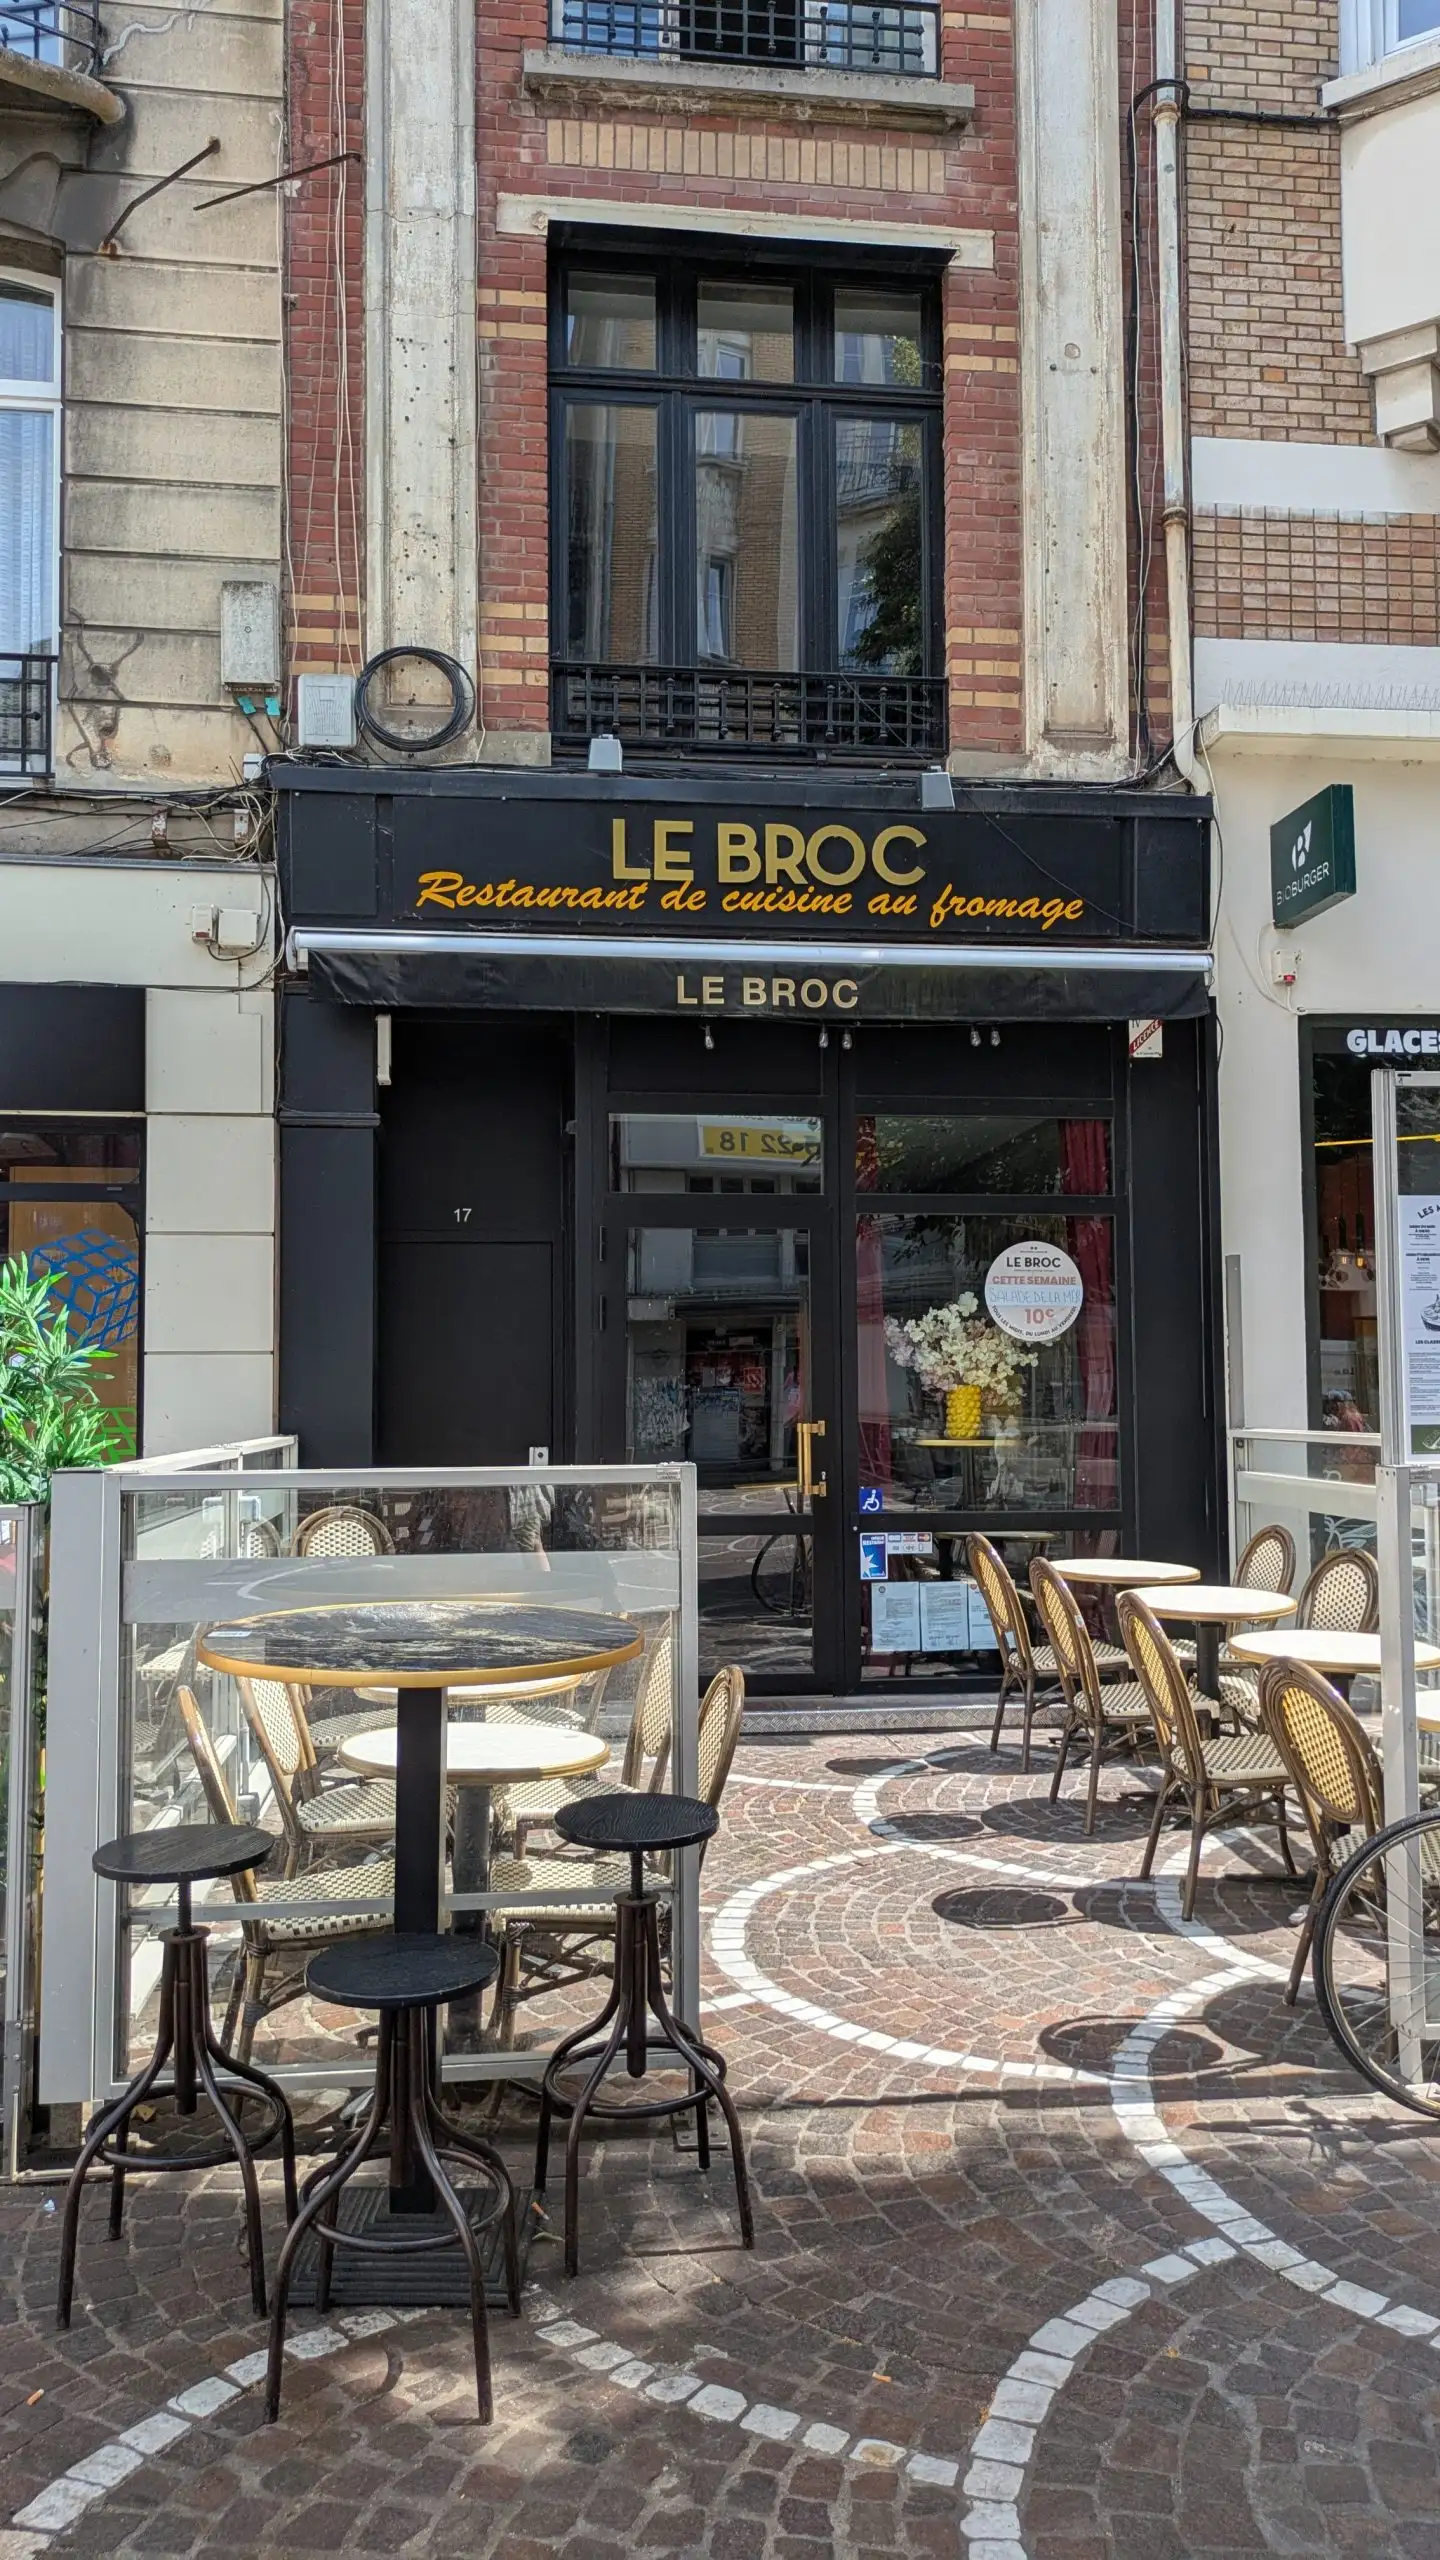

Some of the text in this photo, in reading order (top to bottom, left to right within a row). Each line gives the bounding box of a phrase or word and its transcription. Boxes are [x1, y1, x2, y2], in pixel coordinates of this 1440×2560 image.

[612, 818, 928, 886] LE BROC
[1276, 861, 1330, 906] BIOBURGER
[416, 871, 1085, 931] Restaurant de cuisine au fromage
[676, 975, 859, 1009] LE BROC
[1133, 1021, 1160, 1051] LICENCE
[1346, 1029, 1440, 1053] GLACE
[453, 1207, 472, 1223] 17
[1417, 1206, 1435, 1219] LES
[1006, 1256, 1061, 1268] LE BROC
[992, 1275, 1077, 1285] CETTE SEMAINE
[1024, 1308, 1055, 1325] 10€
